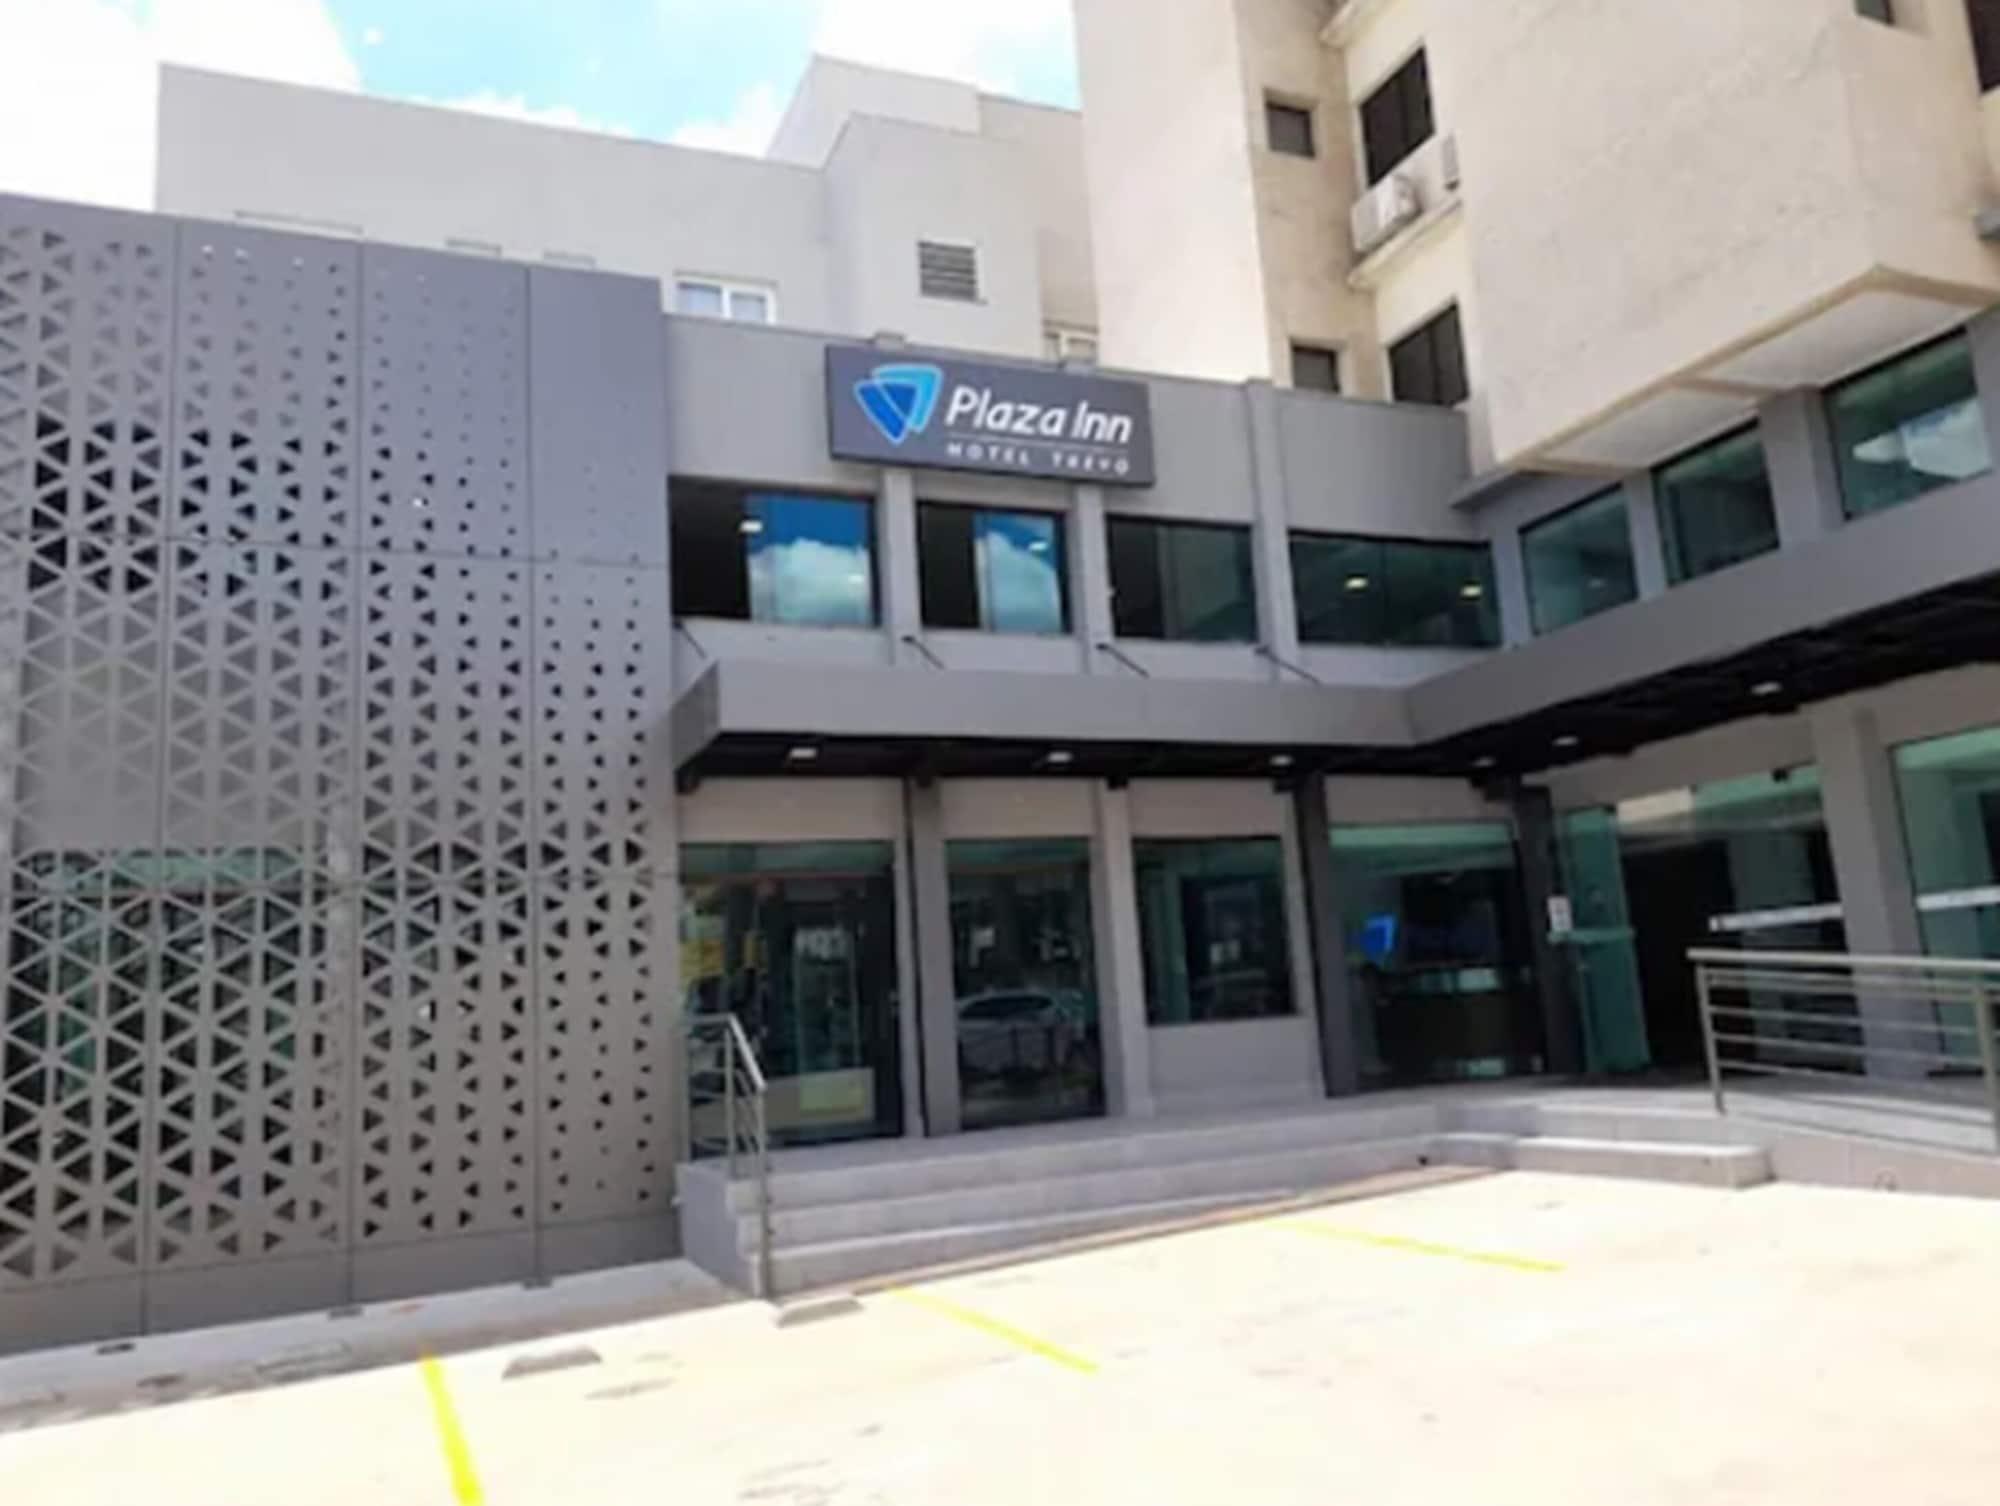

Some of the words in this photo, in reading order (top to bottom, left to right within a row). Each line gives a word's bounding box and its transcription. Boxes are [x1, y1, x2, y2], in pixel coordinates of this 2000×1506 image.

[945, 385, 1066, 437] Plaza
[1071, 400, 1132, 443] Inn
[947, 442, 1030, 465] HOTEL
